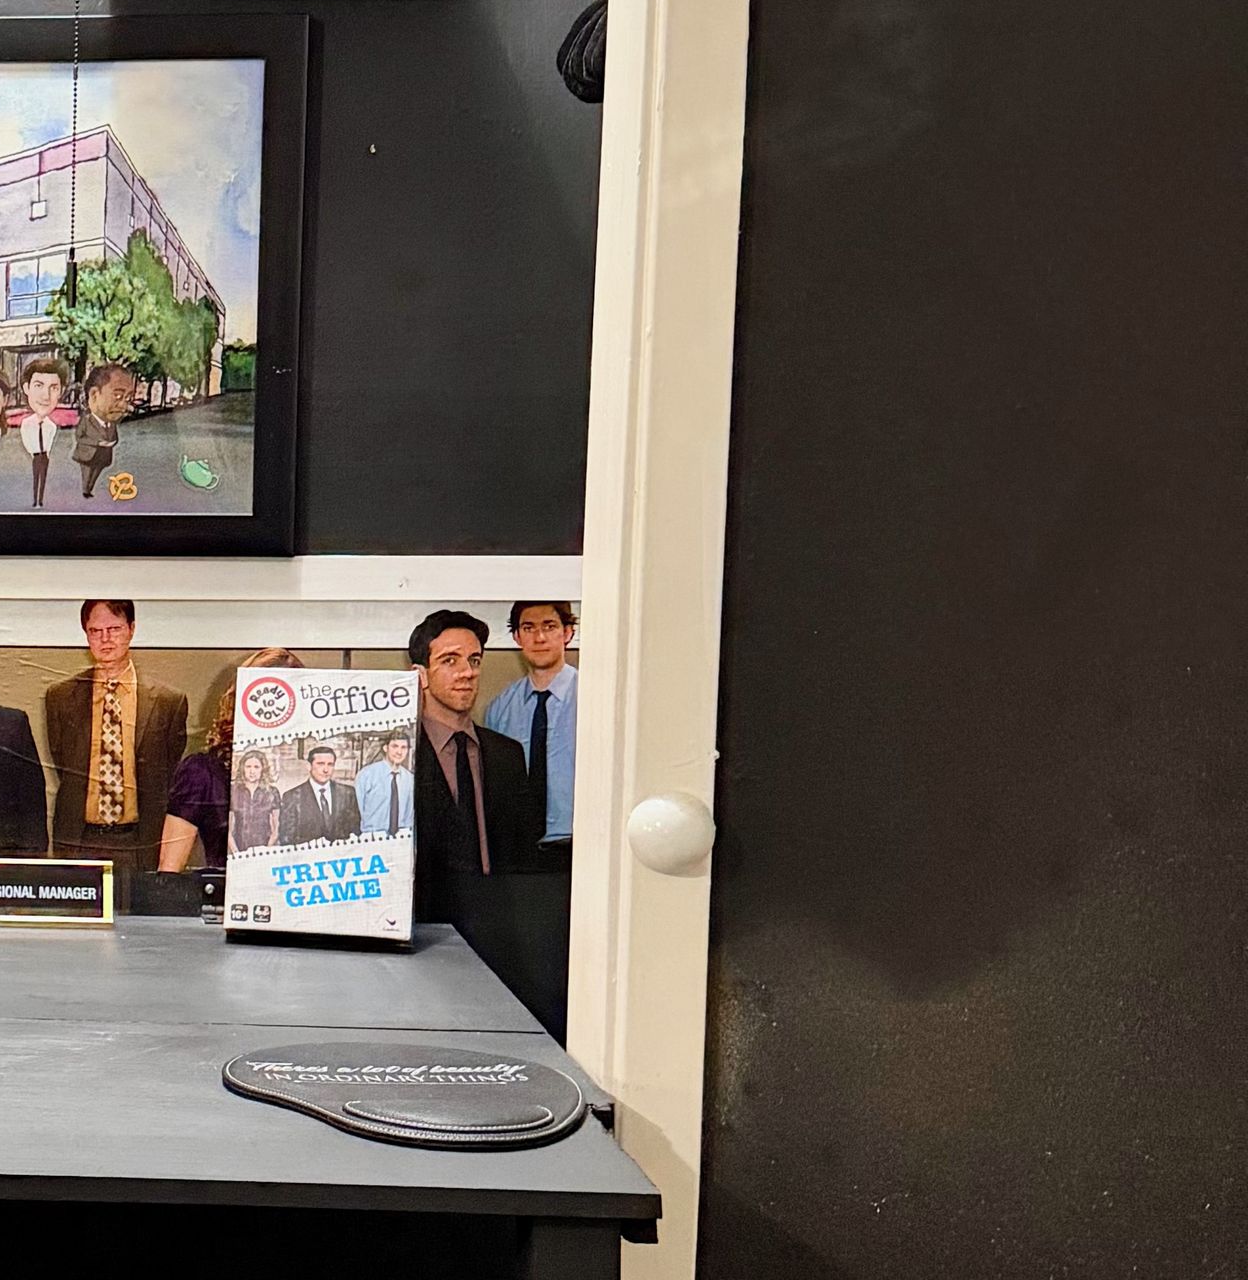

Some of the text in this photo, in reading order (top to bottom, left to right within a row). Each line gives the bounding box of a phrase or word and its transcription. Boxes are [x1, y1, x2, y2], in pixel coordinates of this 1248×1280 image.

[249, 685, 285, 703] Ready
[299, 684, 332, 700] the
[262, 699, 275, 708] to
[310, 685, 411, 719] office
[255, 706, 286, 720] ROLL
[271, 854, 390, 886] TRIVIA
[38, 886, 97, 900] MANAGER
[285, 878, 383, 908] GAME
[264, 1073, 529, 1083] IN ORDINARY THINGS
